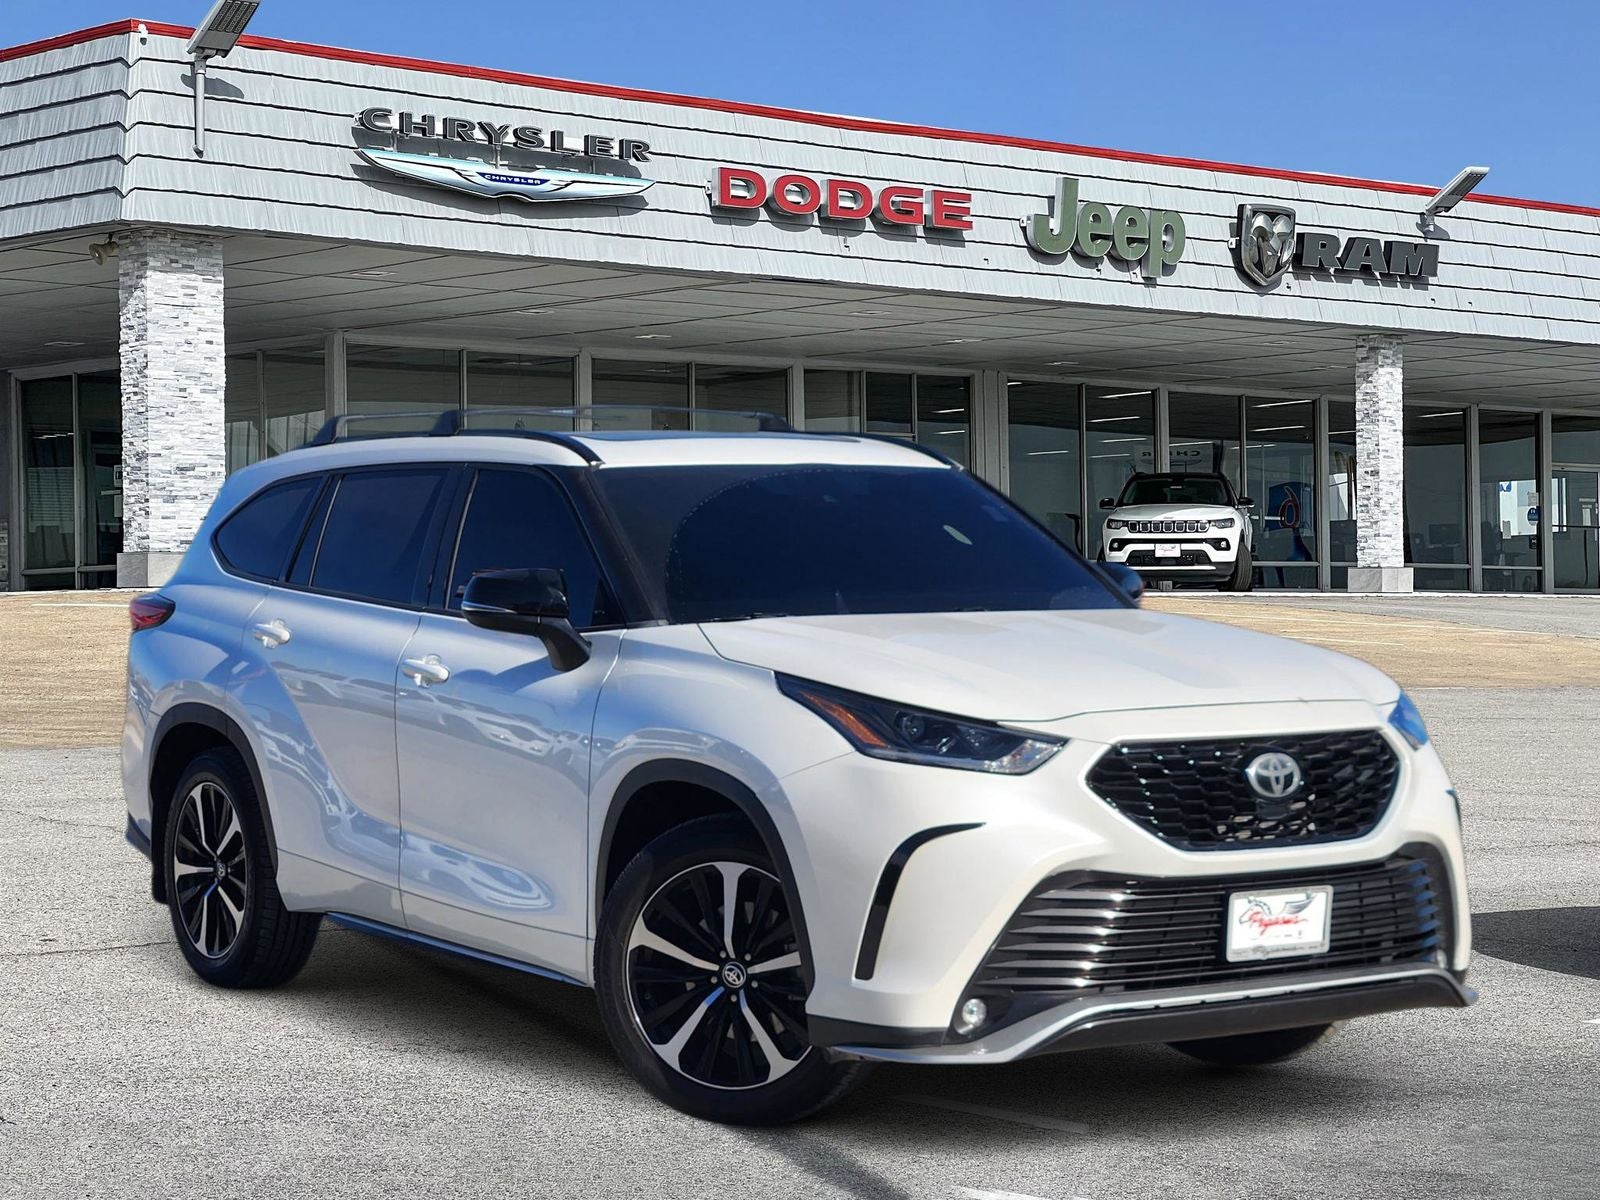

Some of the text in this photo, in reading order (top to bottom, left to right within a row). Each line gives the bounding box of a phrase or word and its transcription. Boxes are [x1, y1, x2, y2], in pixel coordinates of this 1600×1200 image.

[358, 106, 651, 162] CHRYSLER
[484, 174, 541, 185] CHRYSLER
[712, 166, 974, 231] DODGE
[1026, 176, 1187, 279] Jeep
[1296, 231, 1440, 277] RAM
